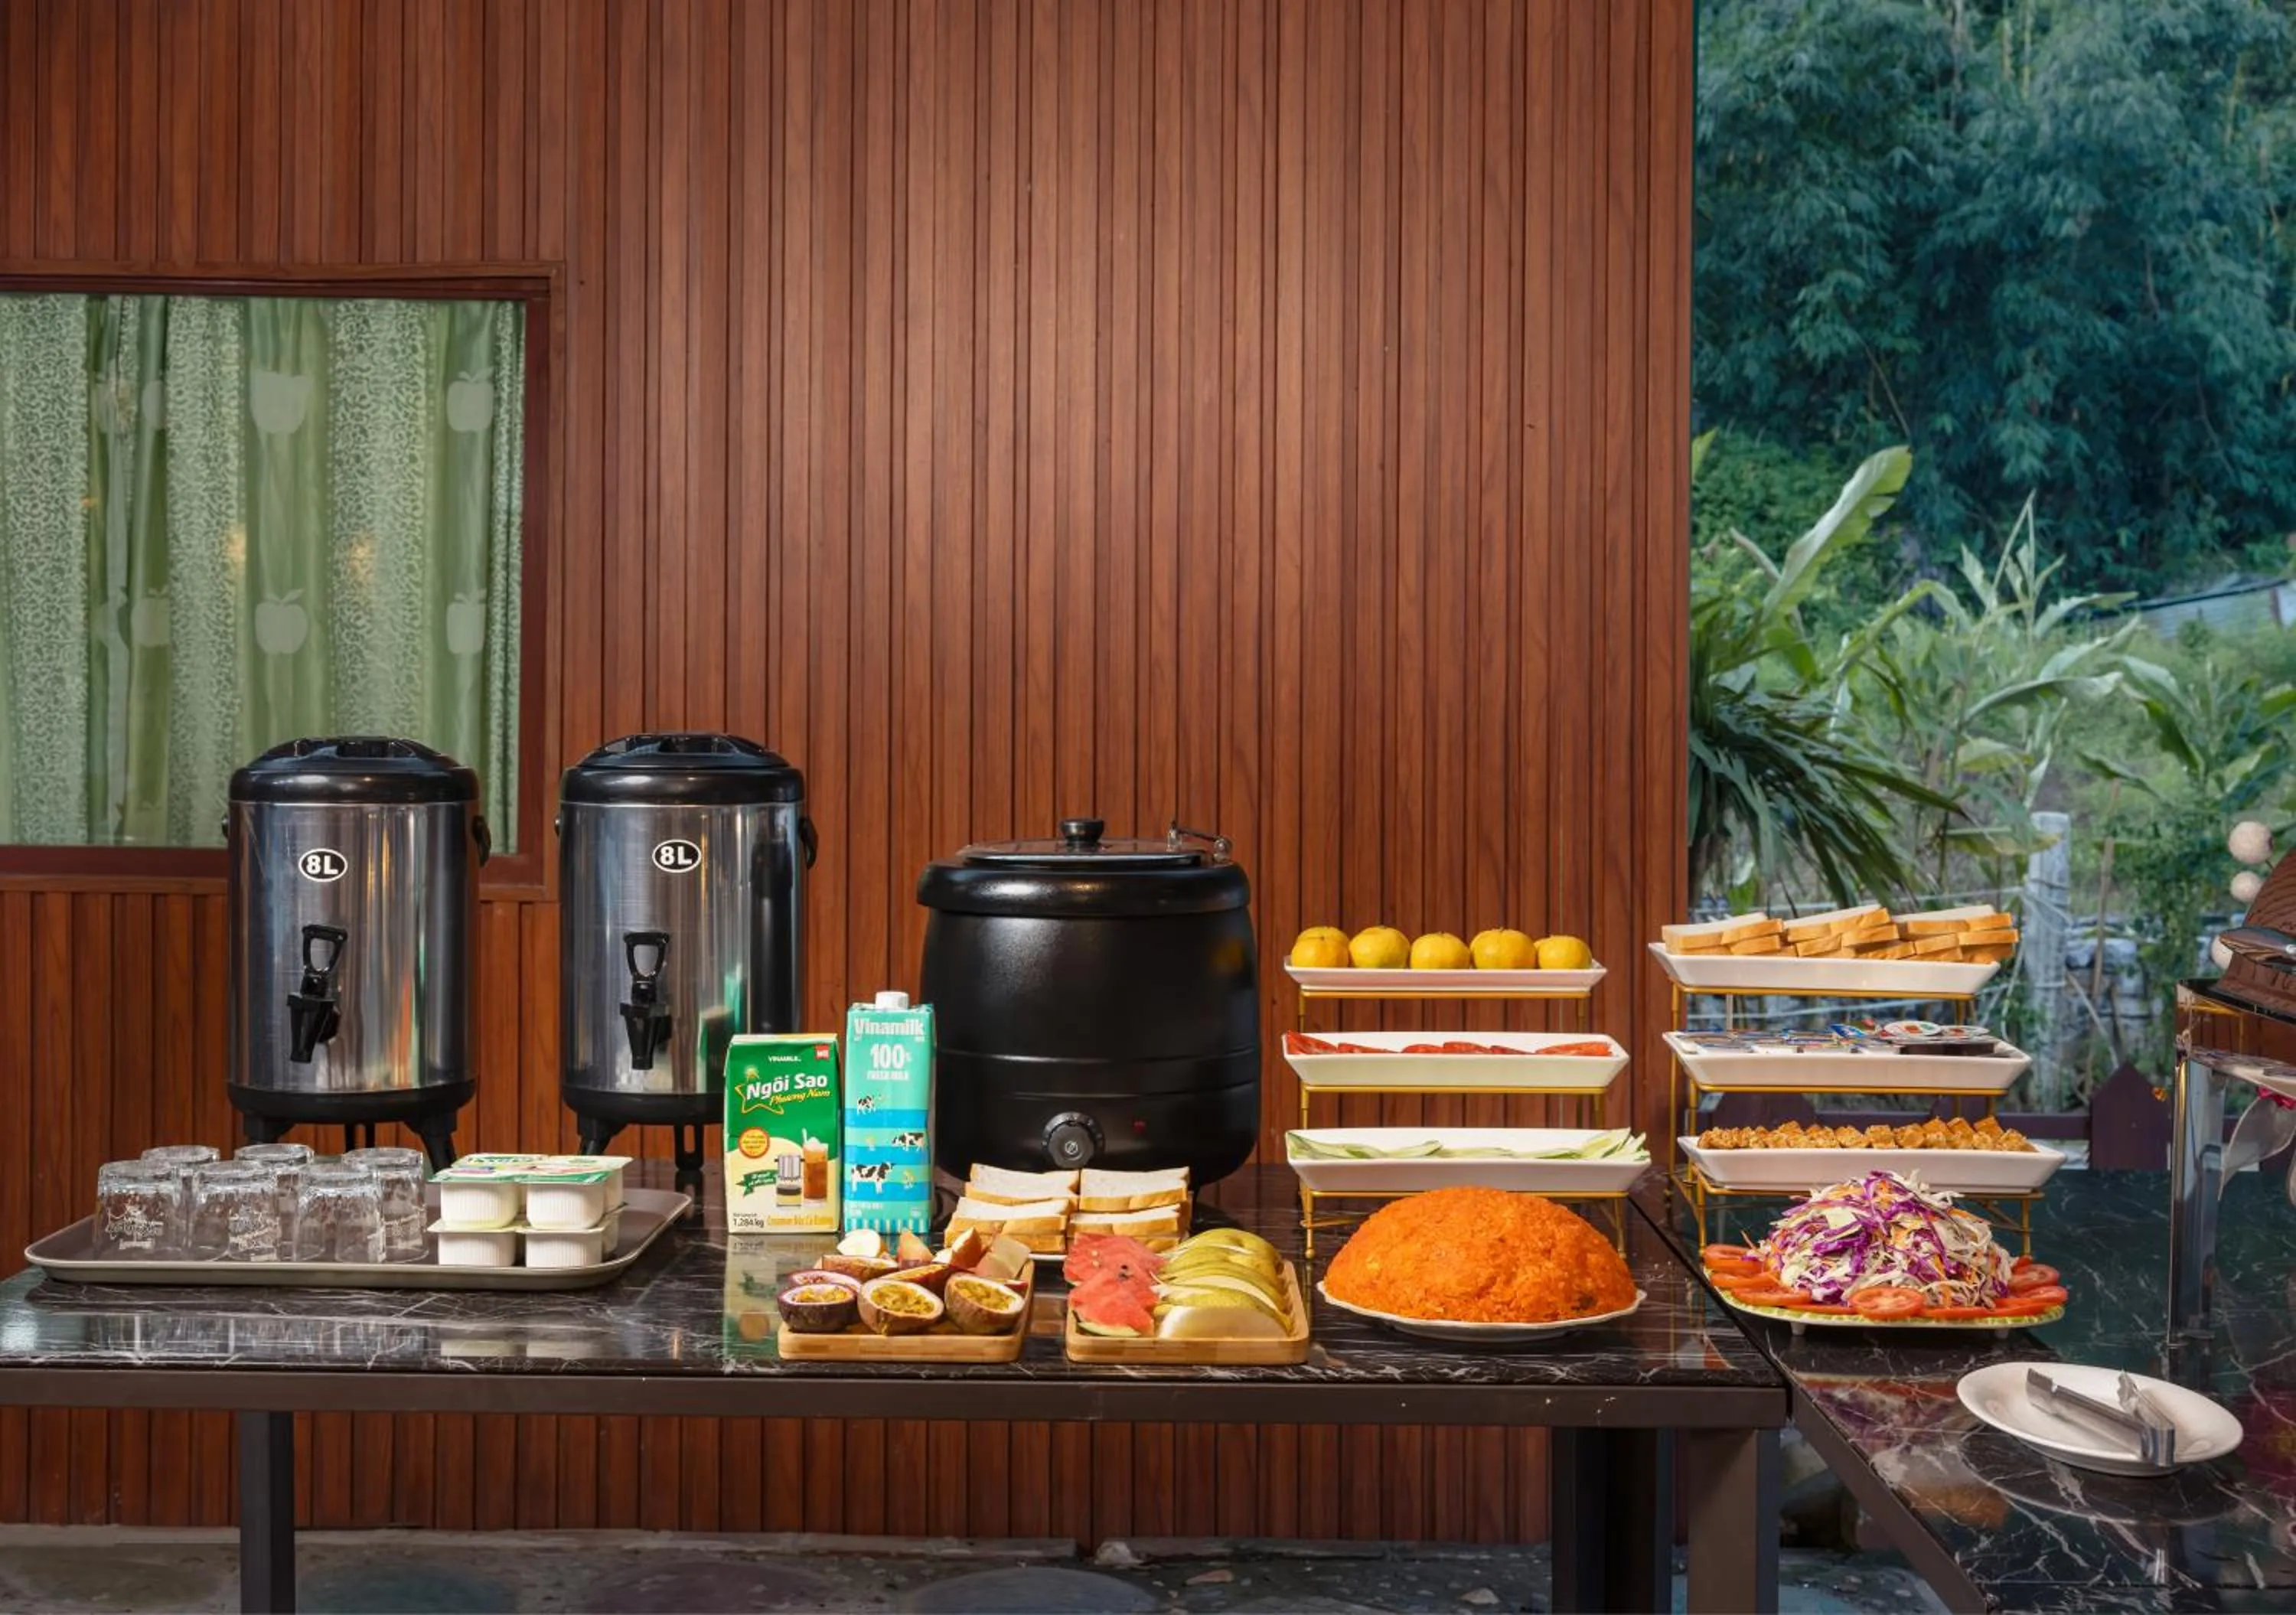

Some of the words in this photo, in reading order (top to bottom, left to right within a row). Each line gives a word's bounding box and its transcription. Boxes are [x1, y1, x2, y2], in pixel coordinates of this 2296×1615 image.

[307, 855, 339, 875] 8L
[660, 846, 693, 866] 8L
[853, 1016, 925, 1036] Vinamilk
[746, 1075, 790, 1101] Ngôi
[794, 1072, 827, 1090] Sao
[807, 1088, 830, 1098] Nam
